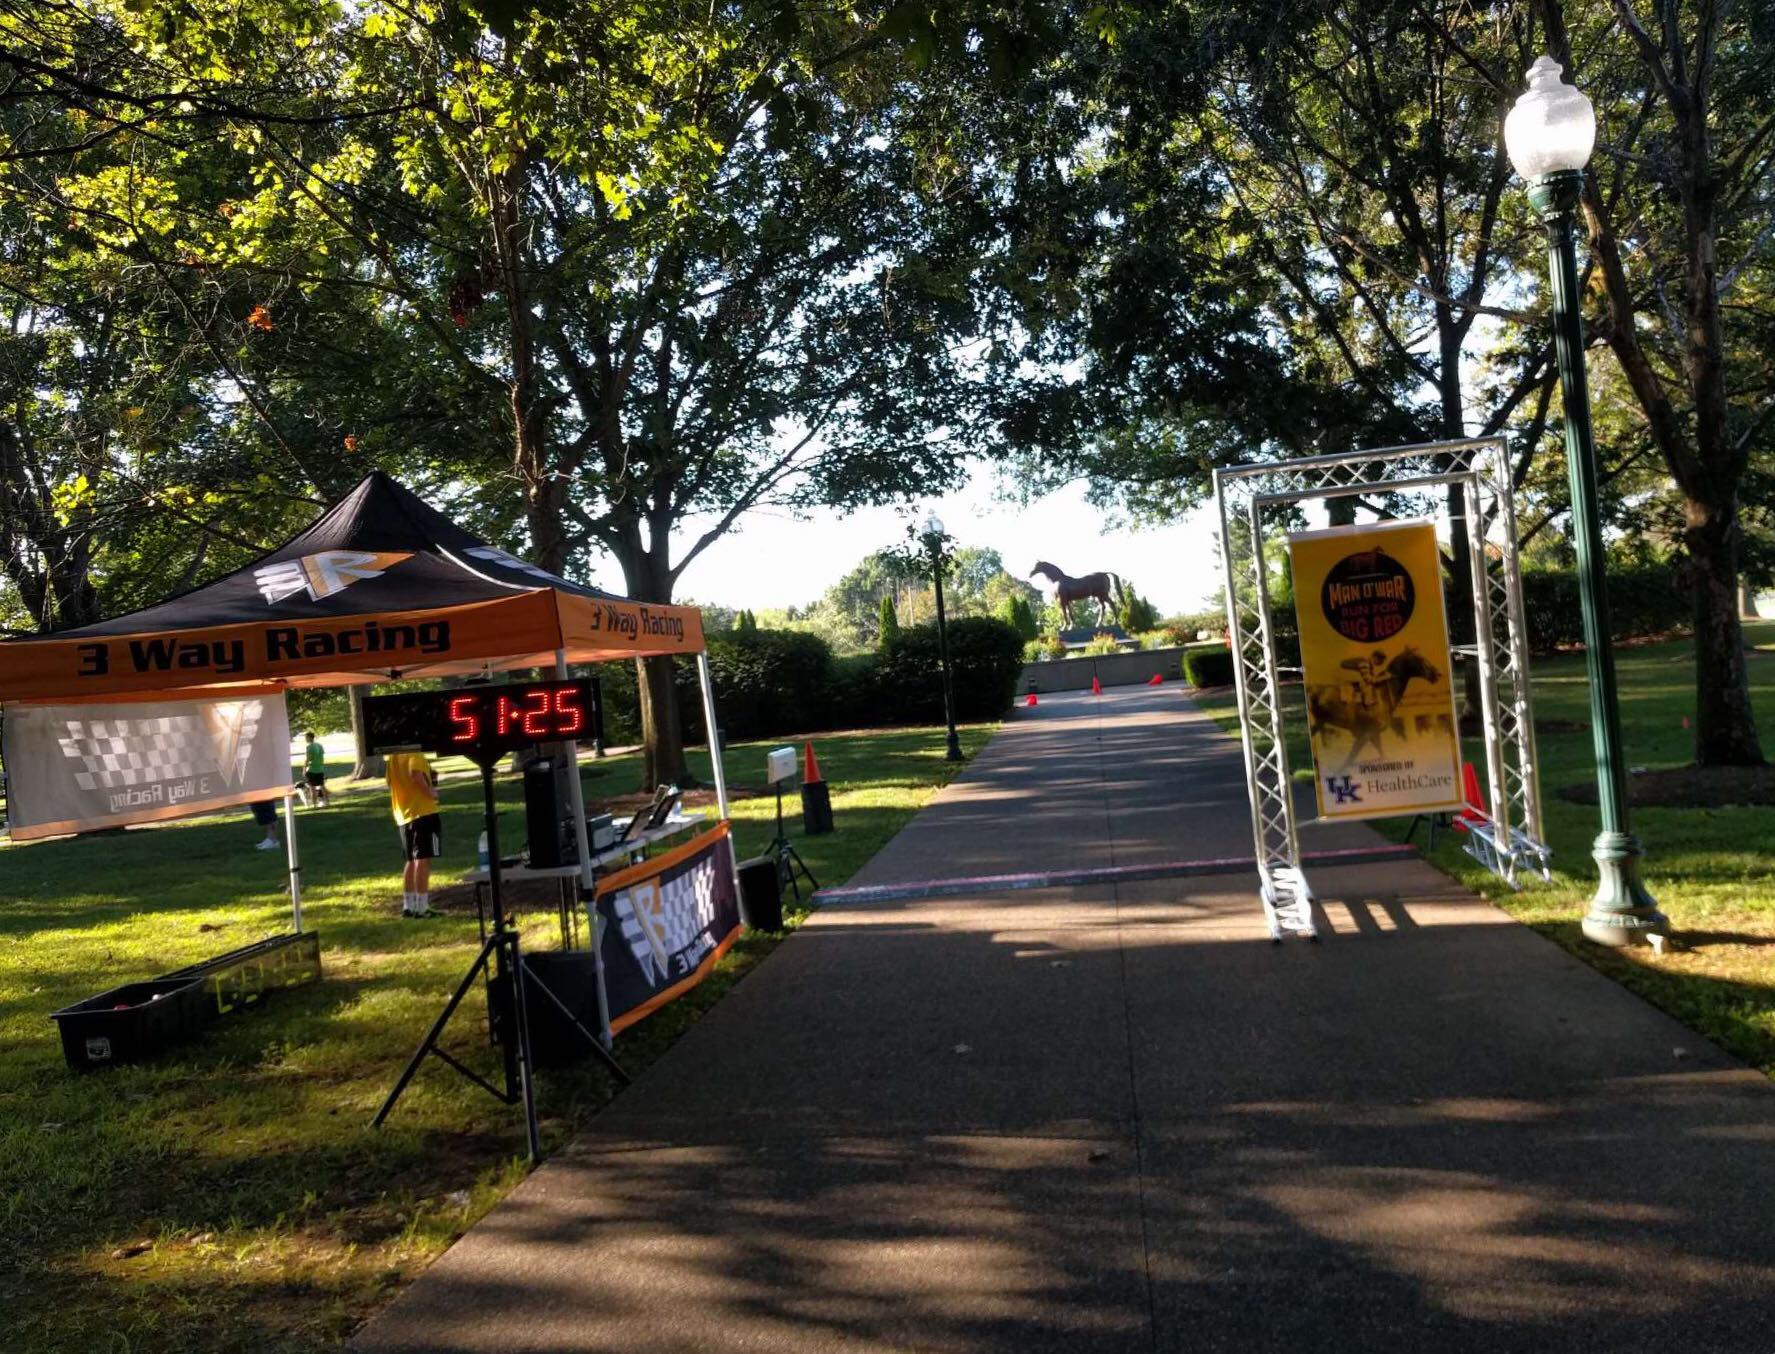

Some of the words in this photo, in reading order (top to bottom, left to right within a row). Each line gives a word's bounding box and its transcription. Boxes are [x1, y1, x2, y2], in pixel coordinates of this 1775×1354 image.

[1329, 583, 1360, 609] MAN
[590, 603, 602, 630] 3
[603, 604, 638, 641] Way
[640, 607, 684, 642] Racing
[1342, 605, 1369, 616] RUN
[1341, 618, 1368, 639] BIG
[1374, 614, 1403, 637] RED
[77, 643, 109, 677] 3
[129, 638, 246, 674] Way
[265, 620, 451, 662] Racing
[1326, 776, 1363, 804] UK
[1367, 775, 1452, 793] HealthCare
[675, 953, 688, 974] 3
